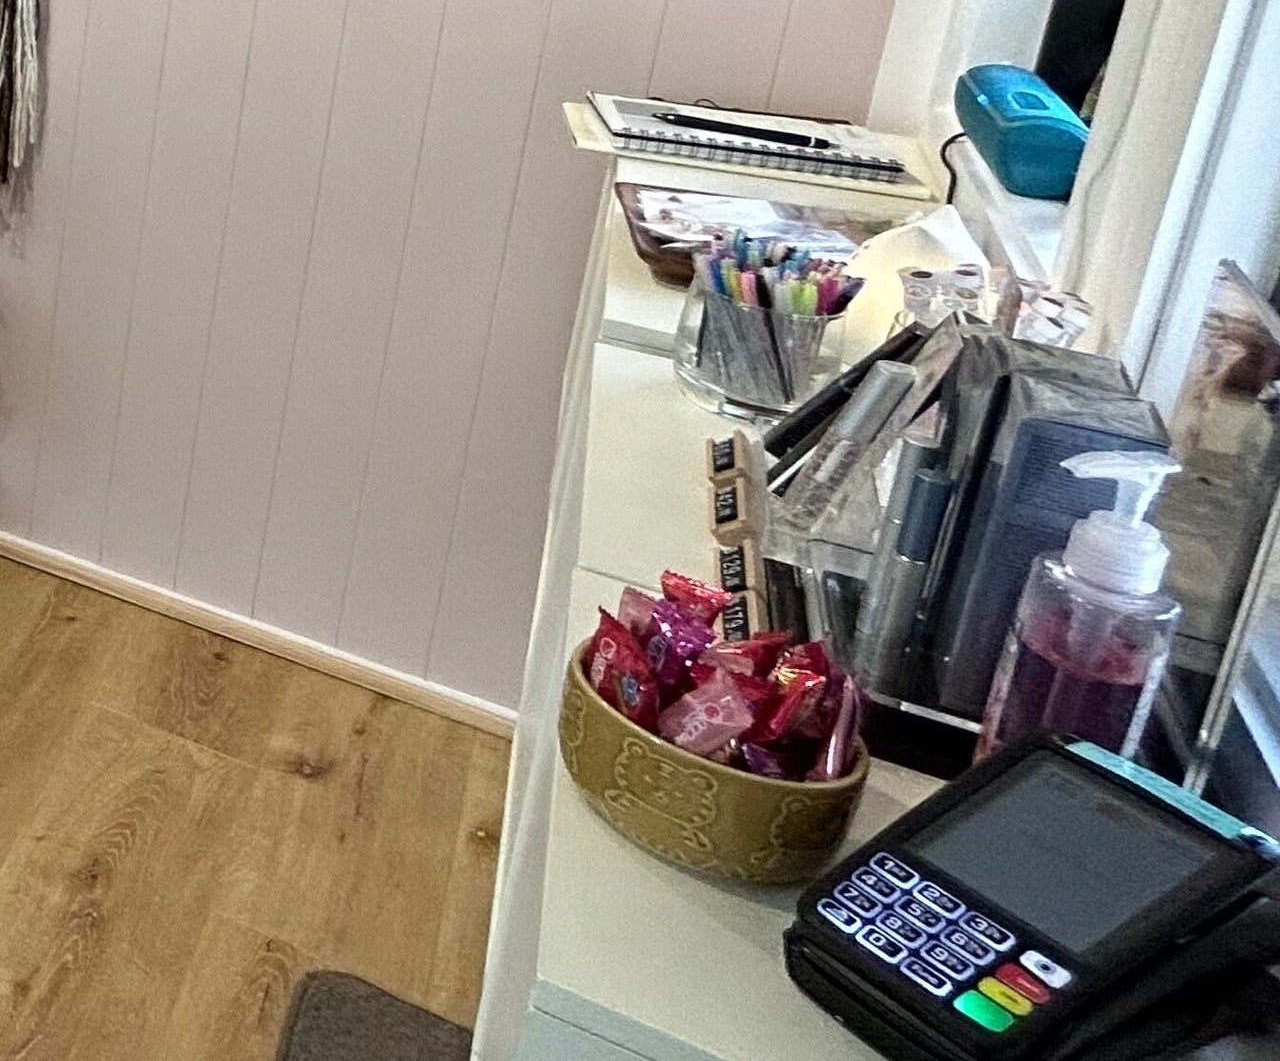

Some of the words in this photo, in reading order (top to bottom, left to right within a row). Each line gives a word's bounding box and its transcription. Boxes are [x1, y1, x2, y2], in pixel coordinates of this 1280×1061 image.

[861, 874, 878, 885] 4
[843, 887, 860, 897] 7
[922, 887, 940, 901] 2
[907, 903, 922, 917] 5
[885, 916, 903, 930] 8
[970, 918, 988, 932] 3
[869, 933, 887, 946] 0
[950, 932, 968, 946] 6
[930, 947, 948, 961] 9
